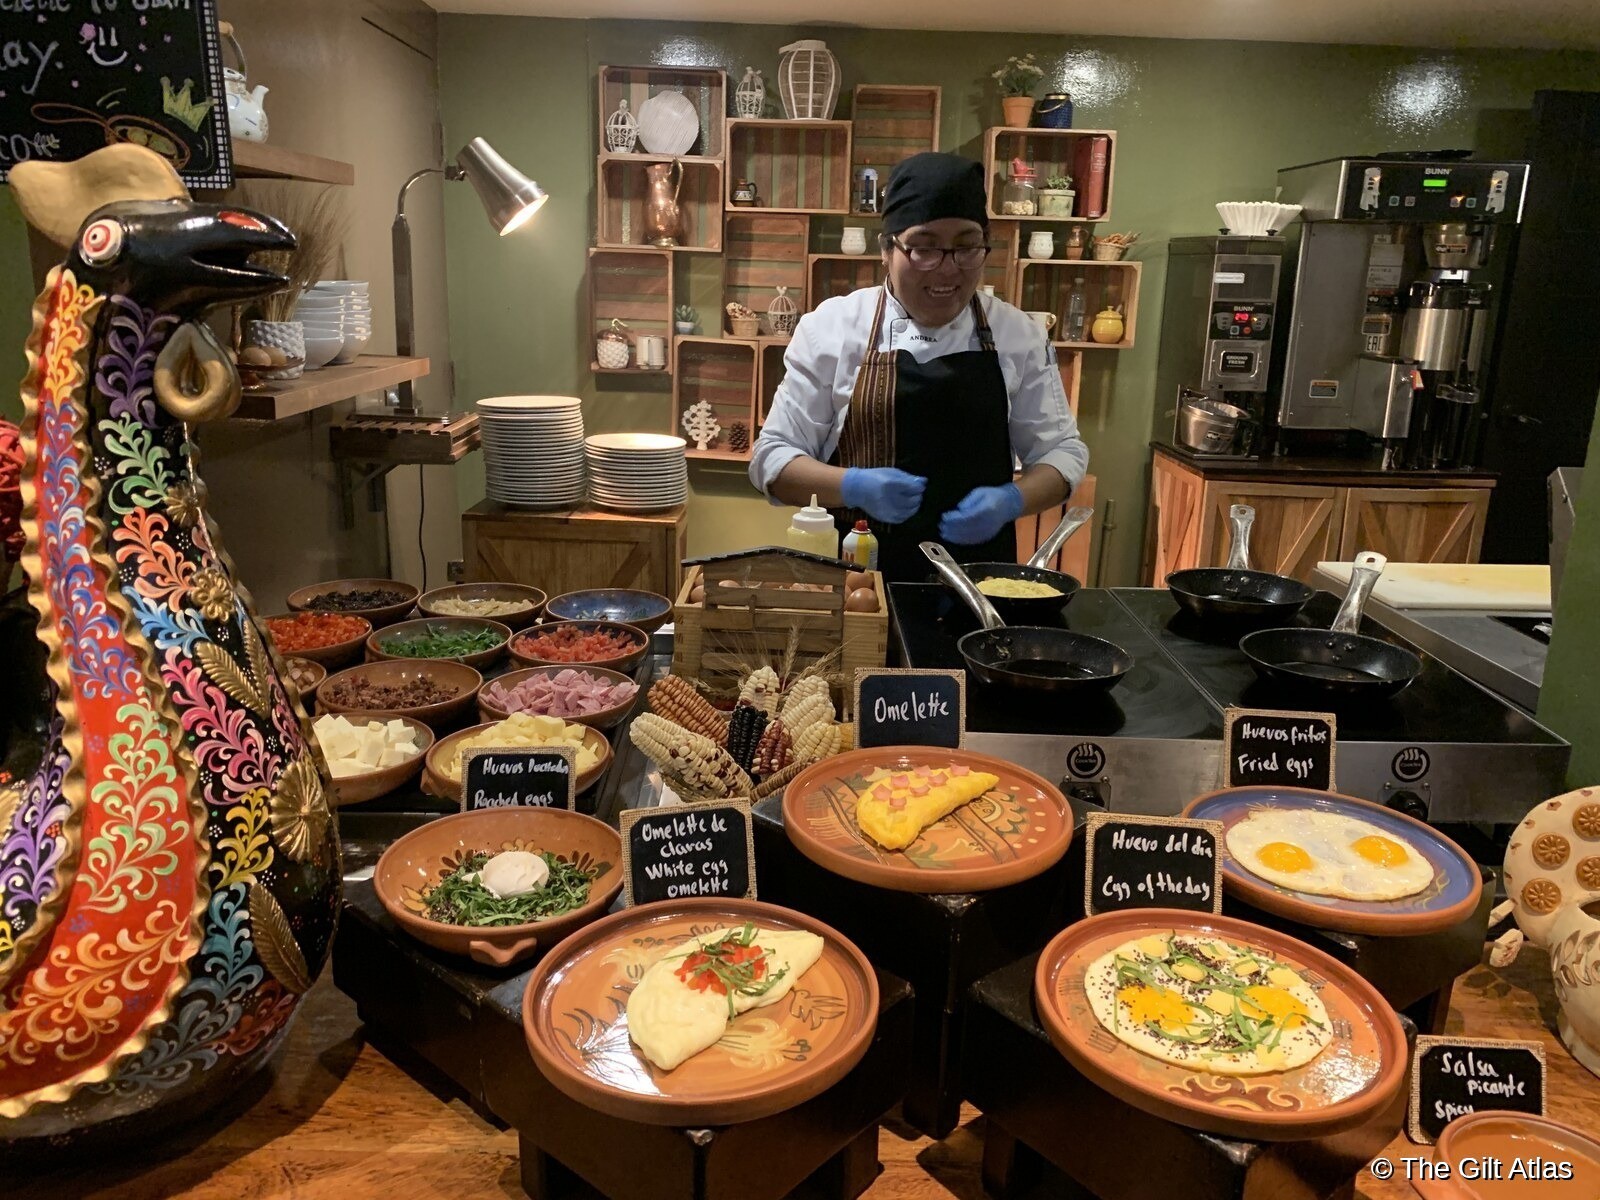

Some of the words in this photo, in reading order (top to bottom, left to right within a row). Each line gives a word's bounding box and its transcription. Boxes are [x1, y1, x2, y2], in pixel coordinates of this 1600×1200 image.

[0, 39, 64, 96] ay.
[910, 335, 938, 343] ANDREA
[874, 691, 949, 723] Omelette
[1242, 722, 1289, 742] Huevos
[482, 756, 524, 776] Huevos
[1237, 752, 1280, 775] Fried
[1286, 757, 1314, 779] eggs
[525, 791, 554, 808] eggs
[641, 813, 708, 842] Omelette
[710, 813, 728, 833] de
[1112, 828, 1158, 853] Huevo
[1164, 832, 1189, 853] del
[1191, 835, 1213, 858] día
[644, 860, 695, 880] White
[701, 859, 729, 876] egg
[1102, 875, 1131, 902] Egg
[1137, 873, 1155, 900] of
[1441, 1051, 1500, 1078] Salsa
